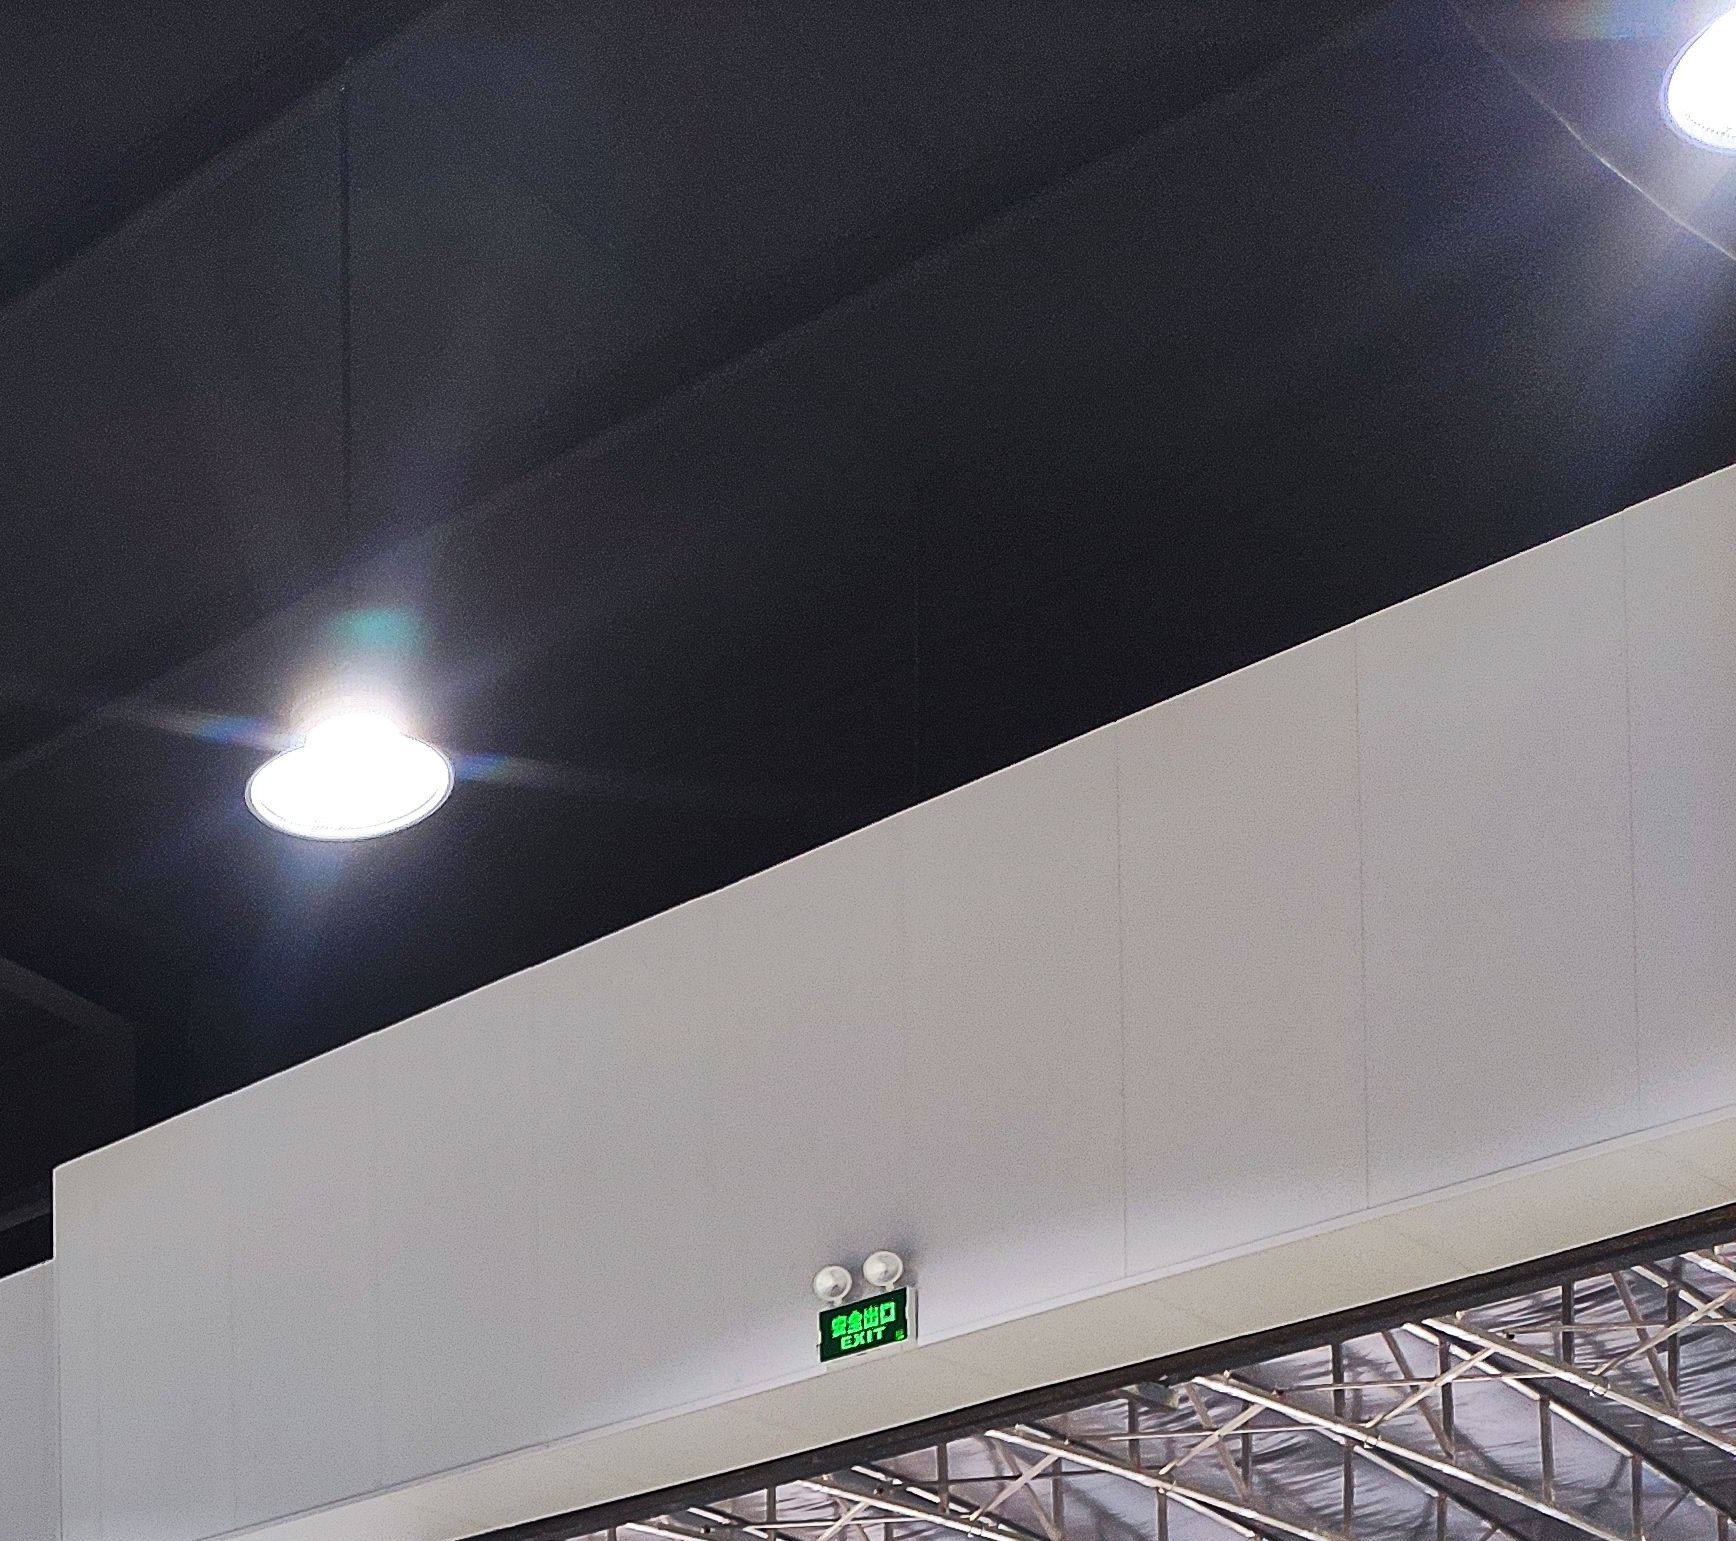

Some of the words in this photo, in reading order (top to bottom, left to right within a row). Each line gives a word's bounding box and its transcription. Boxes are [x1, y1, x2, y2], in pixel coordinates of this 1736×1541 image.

[831, 1301, 896, 1338] 安全出口
[840, 1326, 886, 1350] EXIT
